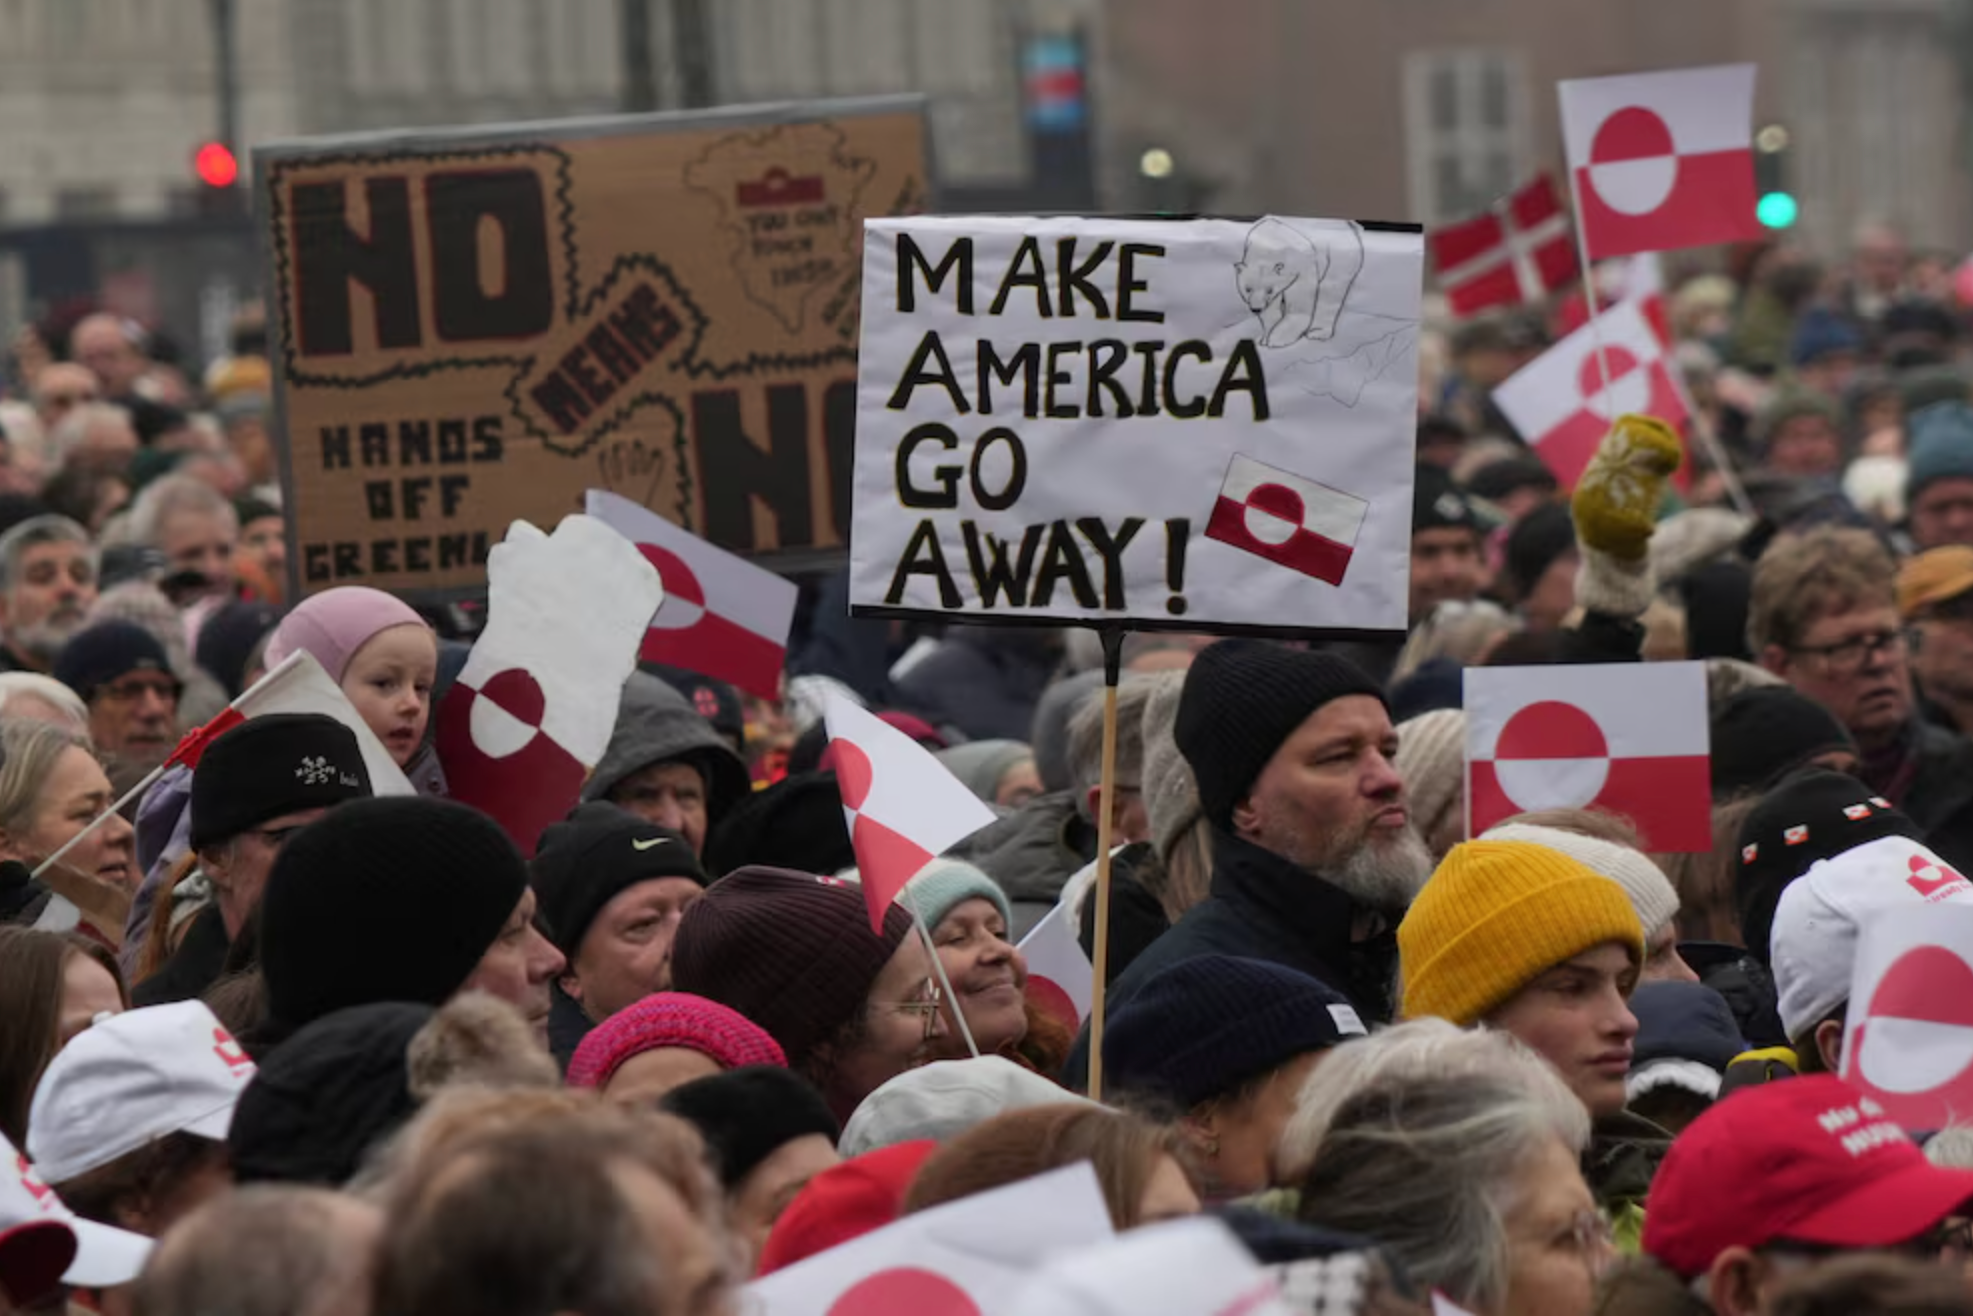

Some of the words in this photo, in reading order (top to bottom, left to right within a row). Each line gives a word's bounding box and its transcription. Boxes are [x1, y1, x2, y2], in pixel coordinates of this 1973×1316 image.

[289, 167, 553, 357] NO
[896, 233, 1166, 323] MAKE
[531, 283, 683, 435] MEANS
[886, 330, 1270, 421] AMERICA
[320, 416, 502, 469] HANDS
[691, 380, 857, 553] N
[895, 422, 1028, 511] GO
[364, 474, 470, 520] OFF
[884, 517, 1190, 616] AWAY!
